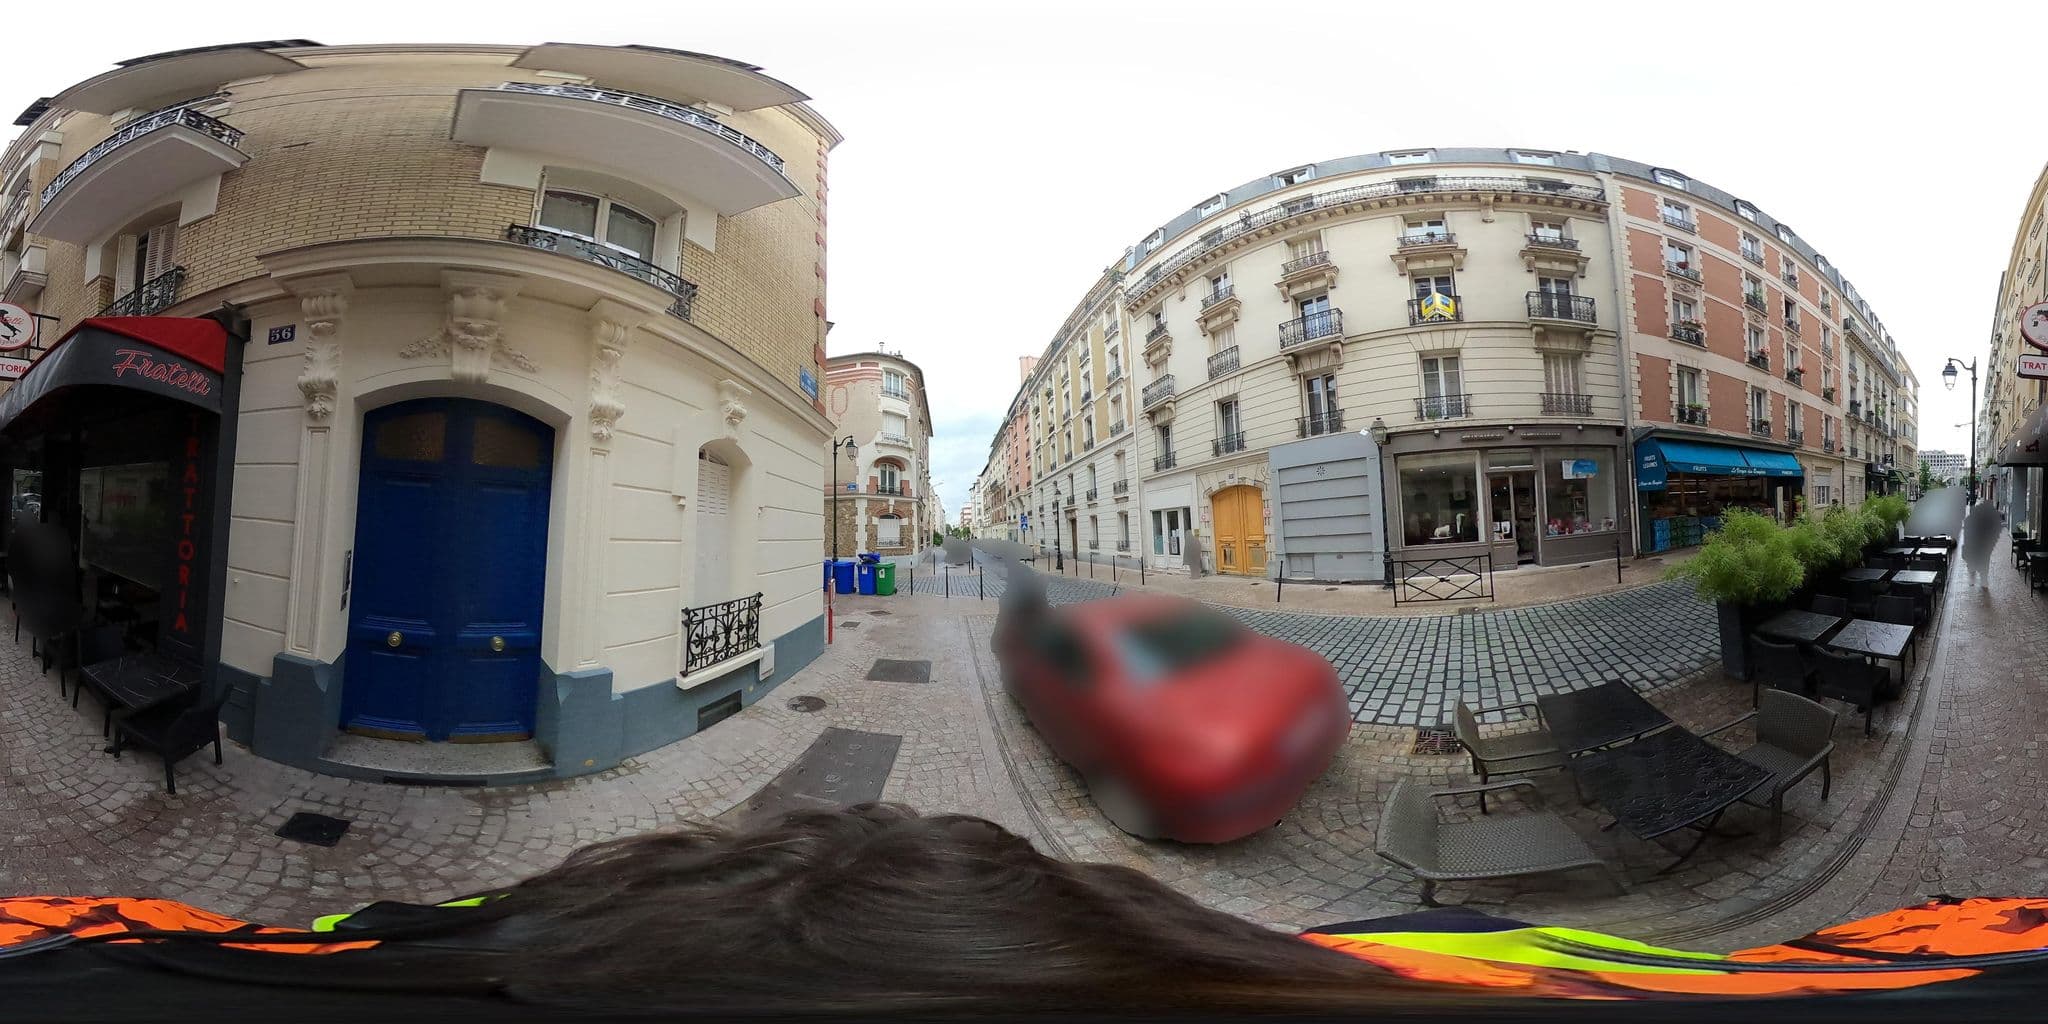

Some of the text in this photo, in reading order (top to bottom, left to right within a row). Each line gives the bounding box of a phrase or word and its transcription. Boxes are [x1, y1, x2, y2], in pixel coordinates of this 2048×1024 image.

[271, 327, 291, 341] 56
[113, 349, 211, 395] Fratelli
[2022, 361, 2048, 371] TRAT
[175, 411, 200, 632] TRATTORIA
